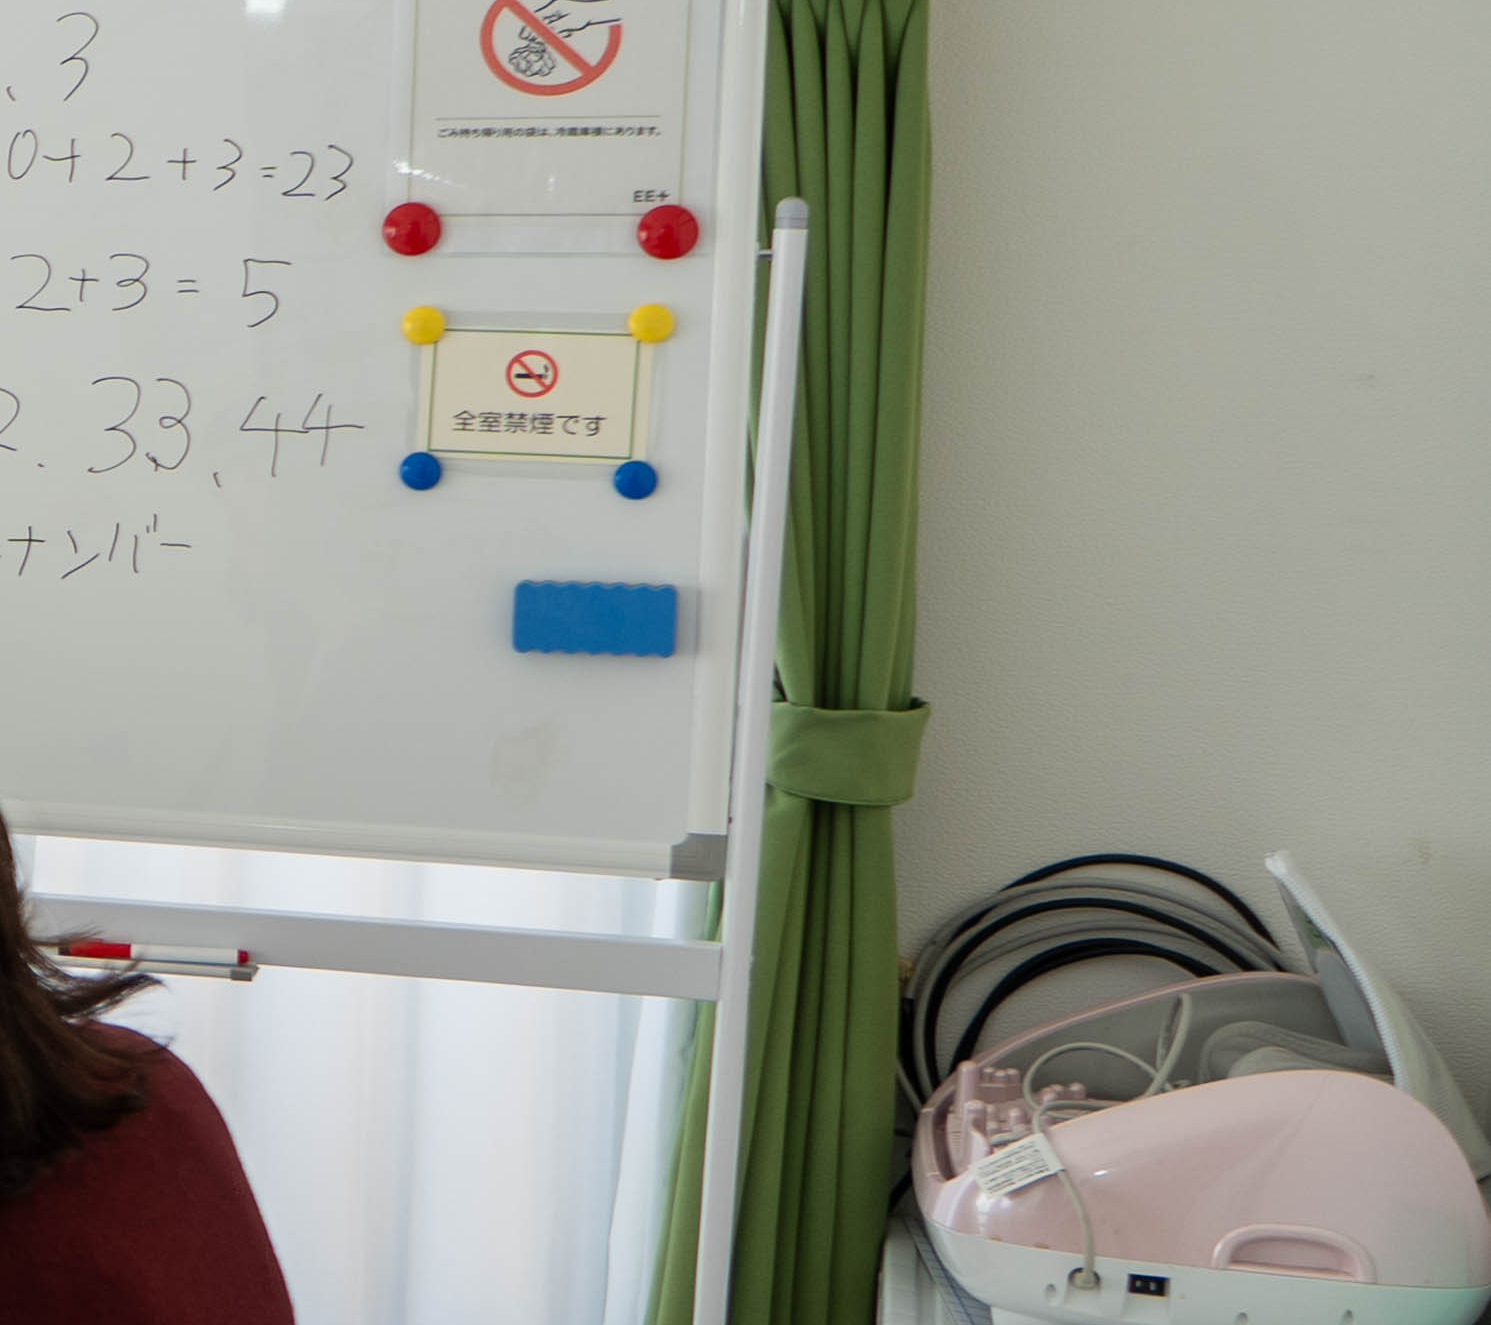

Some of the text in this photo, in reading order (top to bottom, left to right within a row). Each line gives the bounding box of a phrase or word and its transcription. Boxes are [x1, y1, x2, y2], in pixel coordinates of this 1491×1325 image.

[632, 189, 670, 203] EE+
[451, 409, 608, 438] 全室禁煙です
